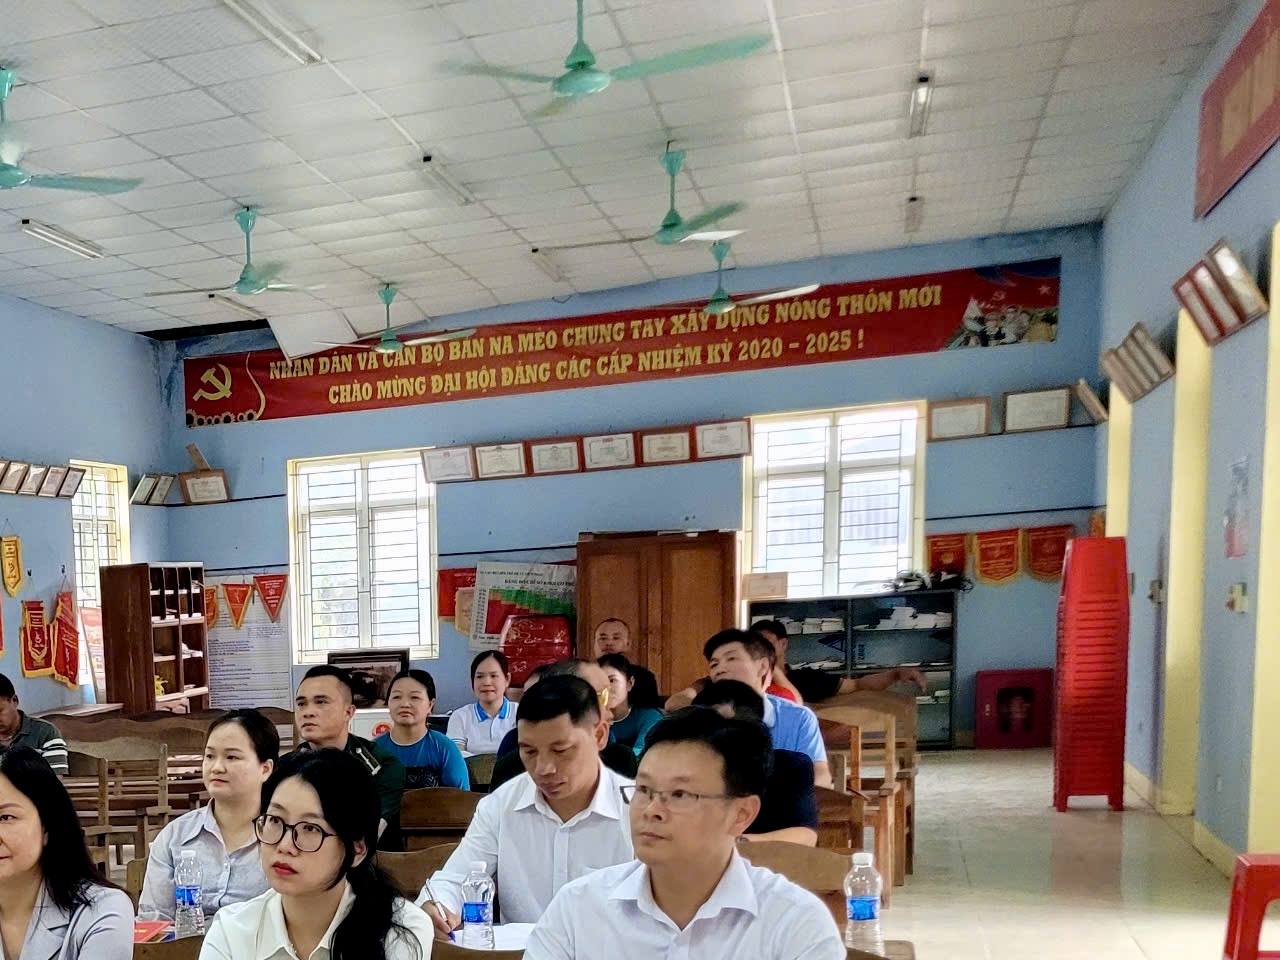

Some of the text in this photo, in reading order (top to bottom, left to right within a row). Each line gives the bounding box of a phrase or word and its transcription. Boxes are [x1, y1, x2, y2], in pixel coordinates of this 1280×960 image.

[319, 351, 353, 375] DÂN
[489, 335, 514, 356] NA
[562, 321, 625, 348] CHUNG
[631, 317, 666, 340] TAY
[670, 308, 710, 335] XÂY
[775, 296, 832, 323] NÔNG
[837, 287, 893, 317] THÔN
[898, 282, 943, 310] MỚI
[328, 379, 373, 405] CHÀO
[431, 372, 462, 396] ĐẠI
[465, 365, 497, 393] HỘI
[501, 360, 551, 386] ĐẢNG
[555, 354, 591, 380] CÁC
[596, 347, 634, 376] CẤP
[637, 343, 702, 373] NHIỆM
[738, 337, 783, 361] 2020
[805, 329, 852, 355] 2025
